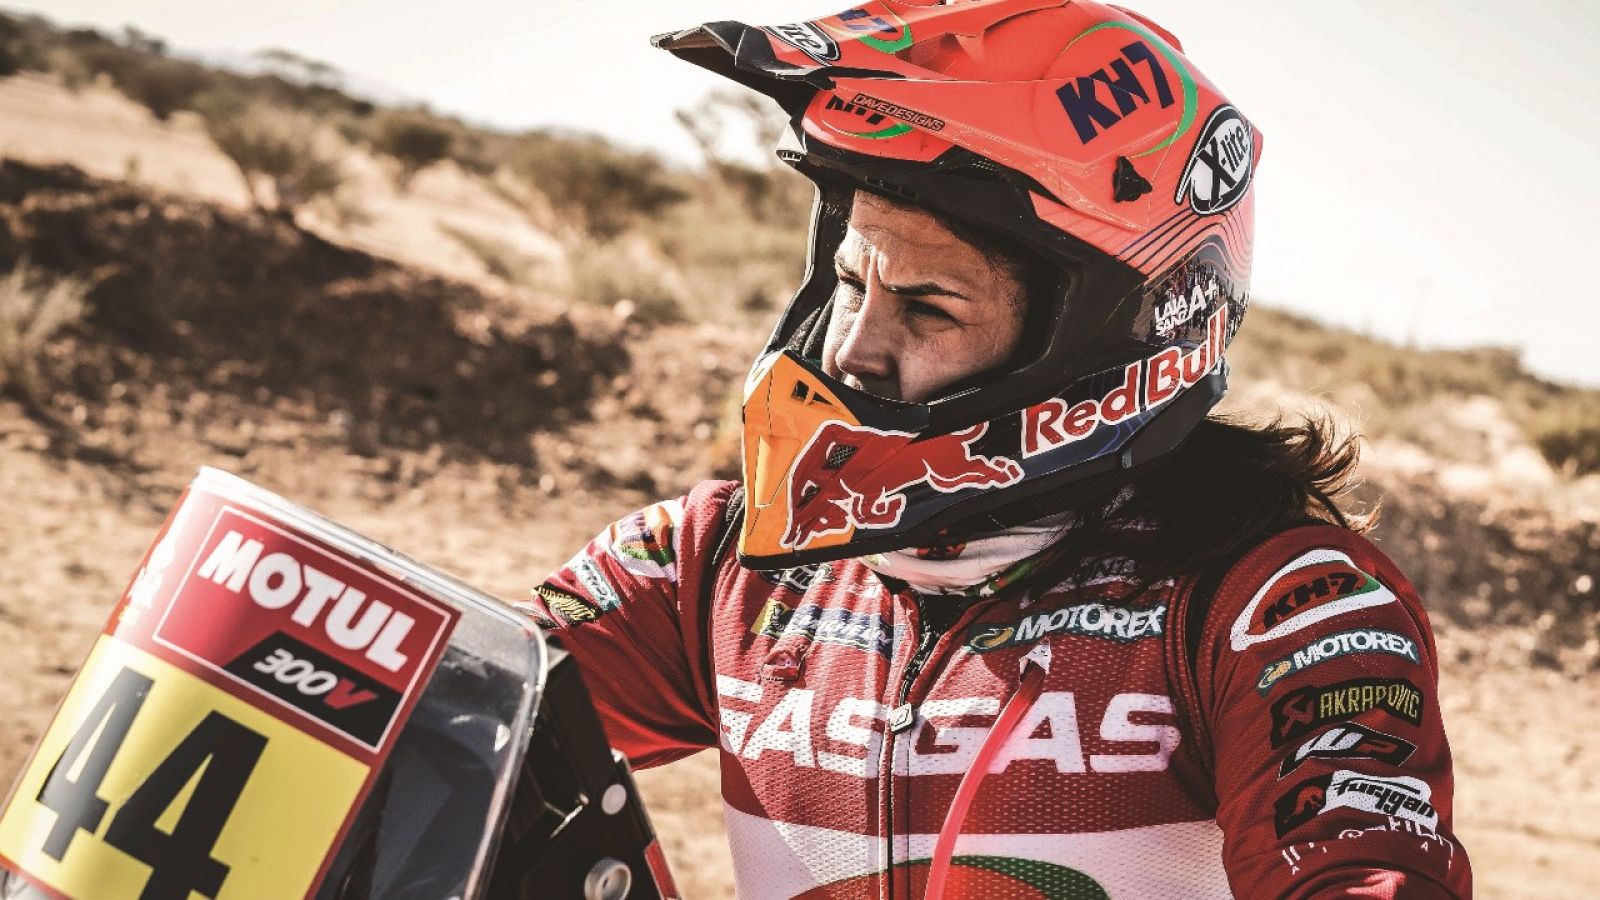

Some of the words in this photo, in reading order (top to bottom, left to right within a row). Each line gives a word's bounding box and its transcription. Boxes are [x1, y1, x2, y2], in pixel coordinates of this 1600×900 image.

[853, 94, 944, 131] DAVEDESIGNS
[1056, 41, 1175, 145] KH7
[1195, 125, 1249, 210] X-lite
[1022, 361, 1141, 458] Red
[1147, 302, 1228, 410] Bull
[197, 530, 416, 674] MOTUL
[1014, 602, 1167, 641] MOTOREX
[1264, 571, 1360, 629] KH7
[253, 647, 377, 710] 300V
[1293, 631, 1417, 670] MOTOREX
[36, 665, 270, 900] 44
